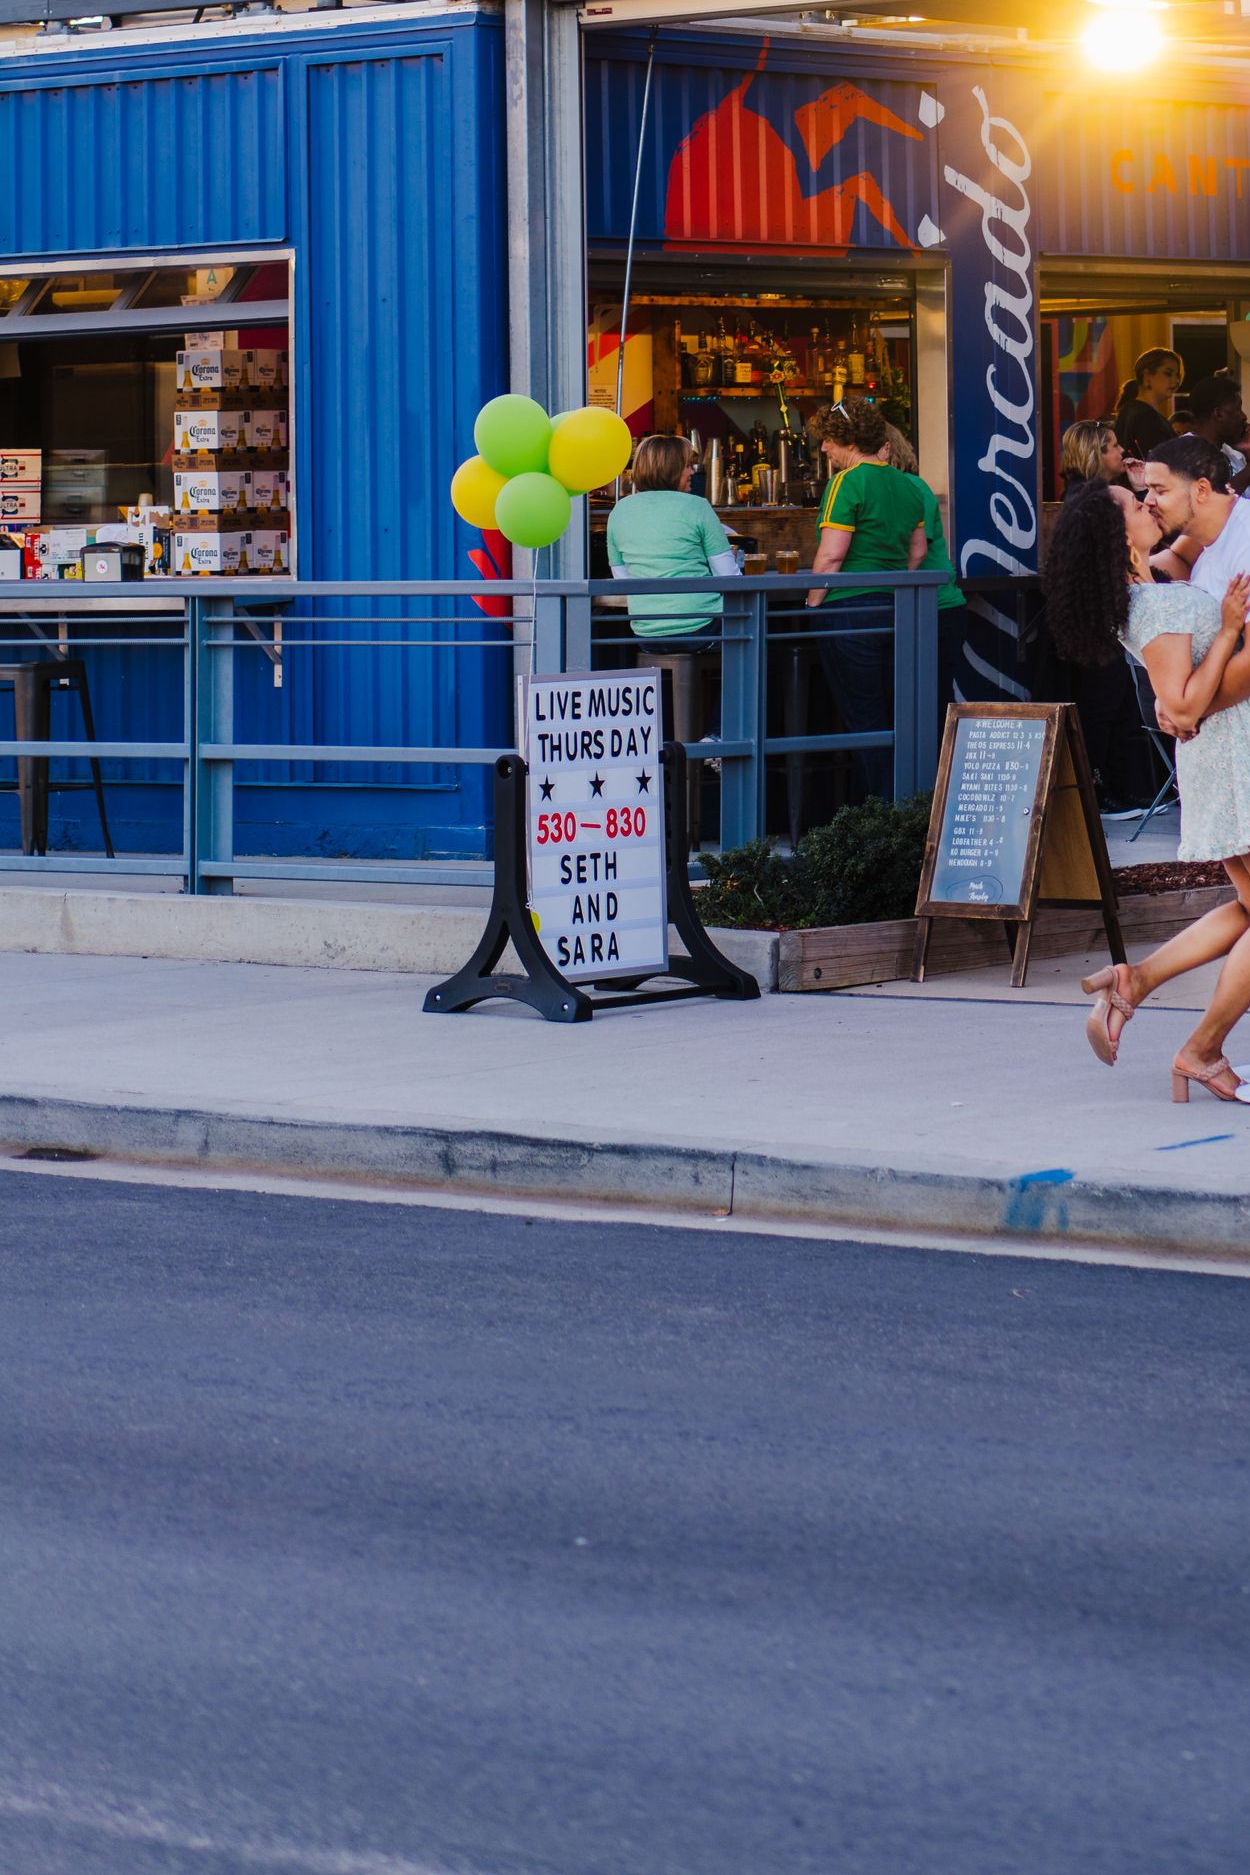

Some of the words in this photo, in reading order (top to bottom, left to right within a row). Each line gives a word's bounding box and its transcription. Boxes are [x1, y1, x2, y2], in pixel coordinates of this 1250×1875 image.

[191, 364, 219, 376] Corona
[189, 425, 216, 437] Corona
[189, 486, 216, 498] Corona
[191, 547, 218, 559] Corona
[535, 690, 582, 721] LIVE
[588, 685, 654, 717] MUSIC
[968, 731, 986, 739] PASTA
[989, 731, 1010, 739] ADDICT
[988, 741, 1015, 749] EXPRESS
[982, 762, 1000, 770] PIZZA
[983, 783, 1003, 791] BITES
[957, 793, 995, 801] COCOBOWLZ
[957, 803, 988, 812] MERCADO
[952, 837, 988, 846] LOBFATHER
[959, 848, 982, 856] BURGER
[560, 851, 617, 885] SETH
[572, 891, 618, 925] AND
[557, 931, 619, 967] SARA
